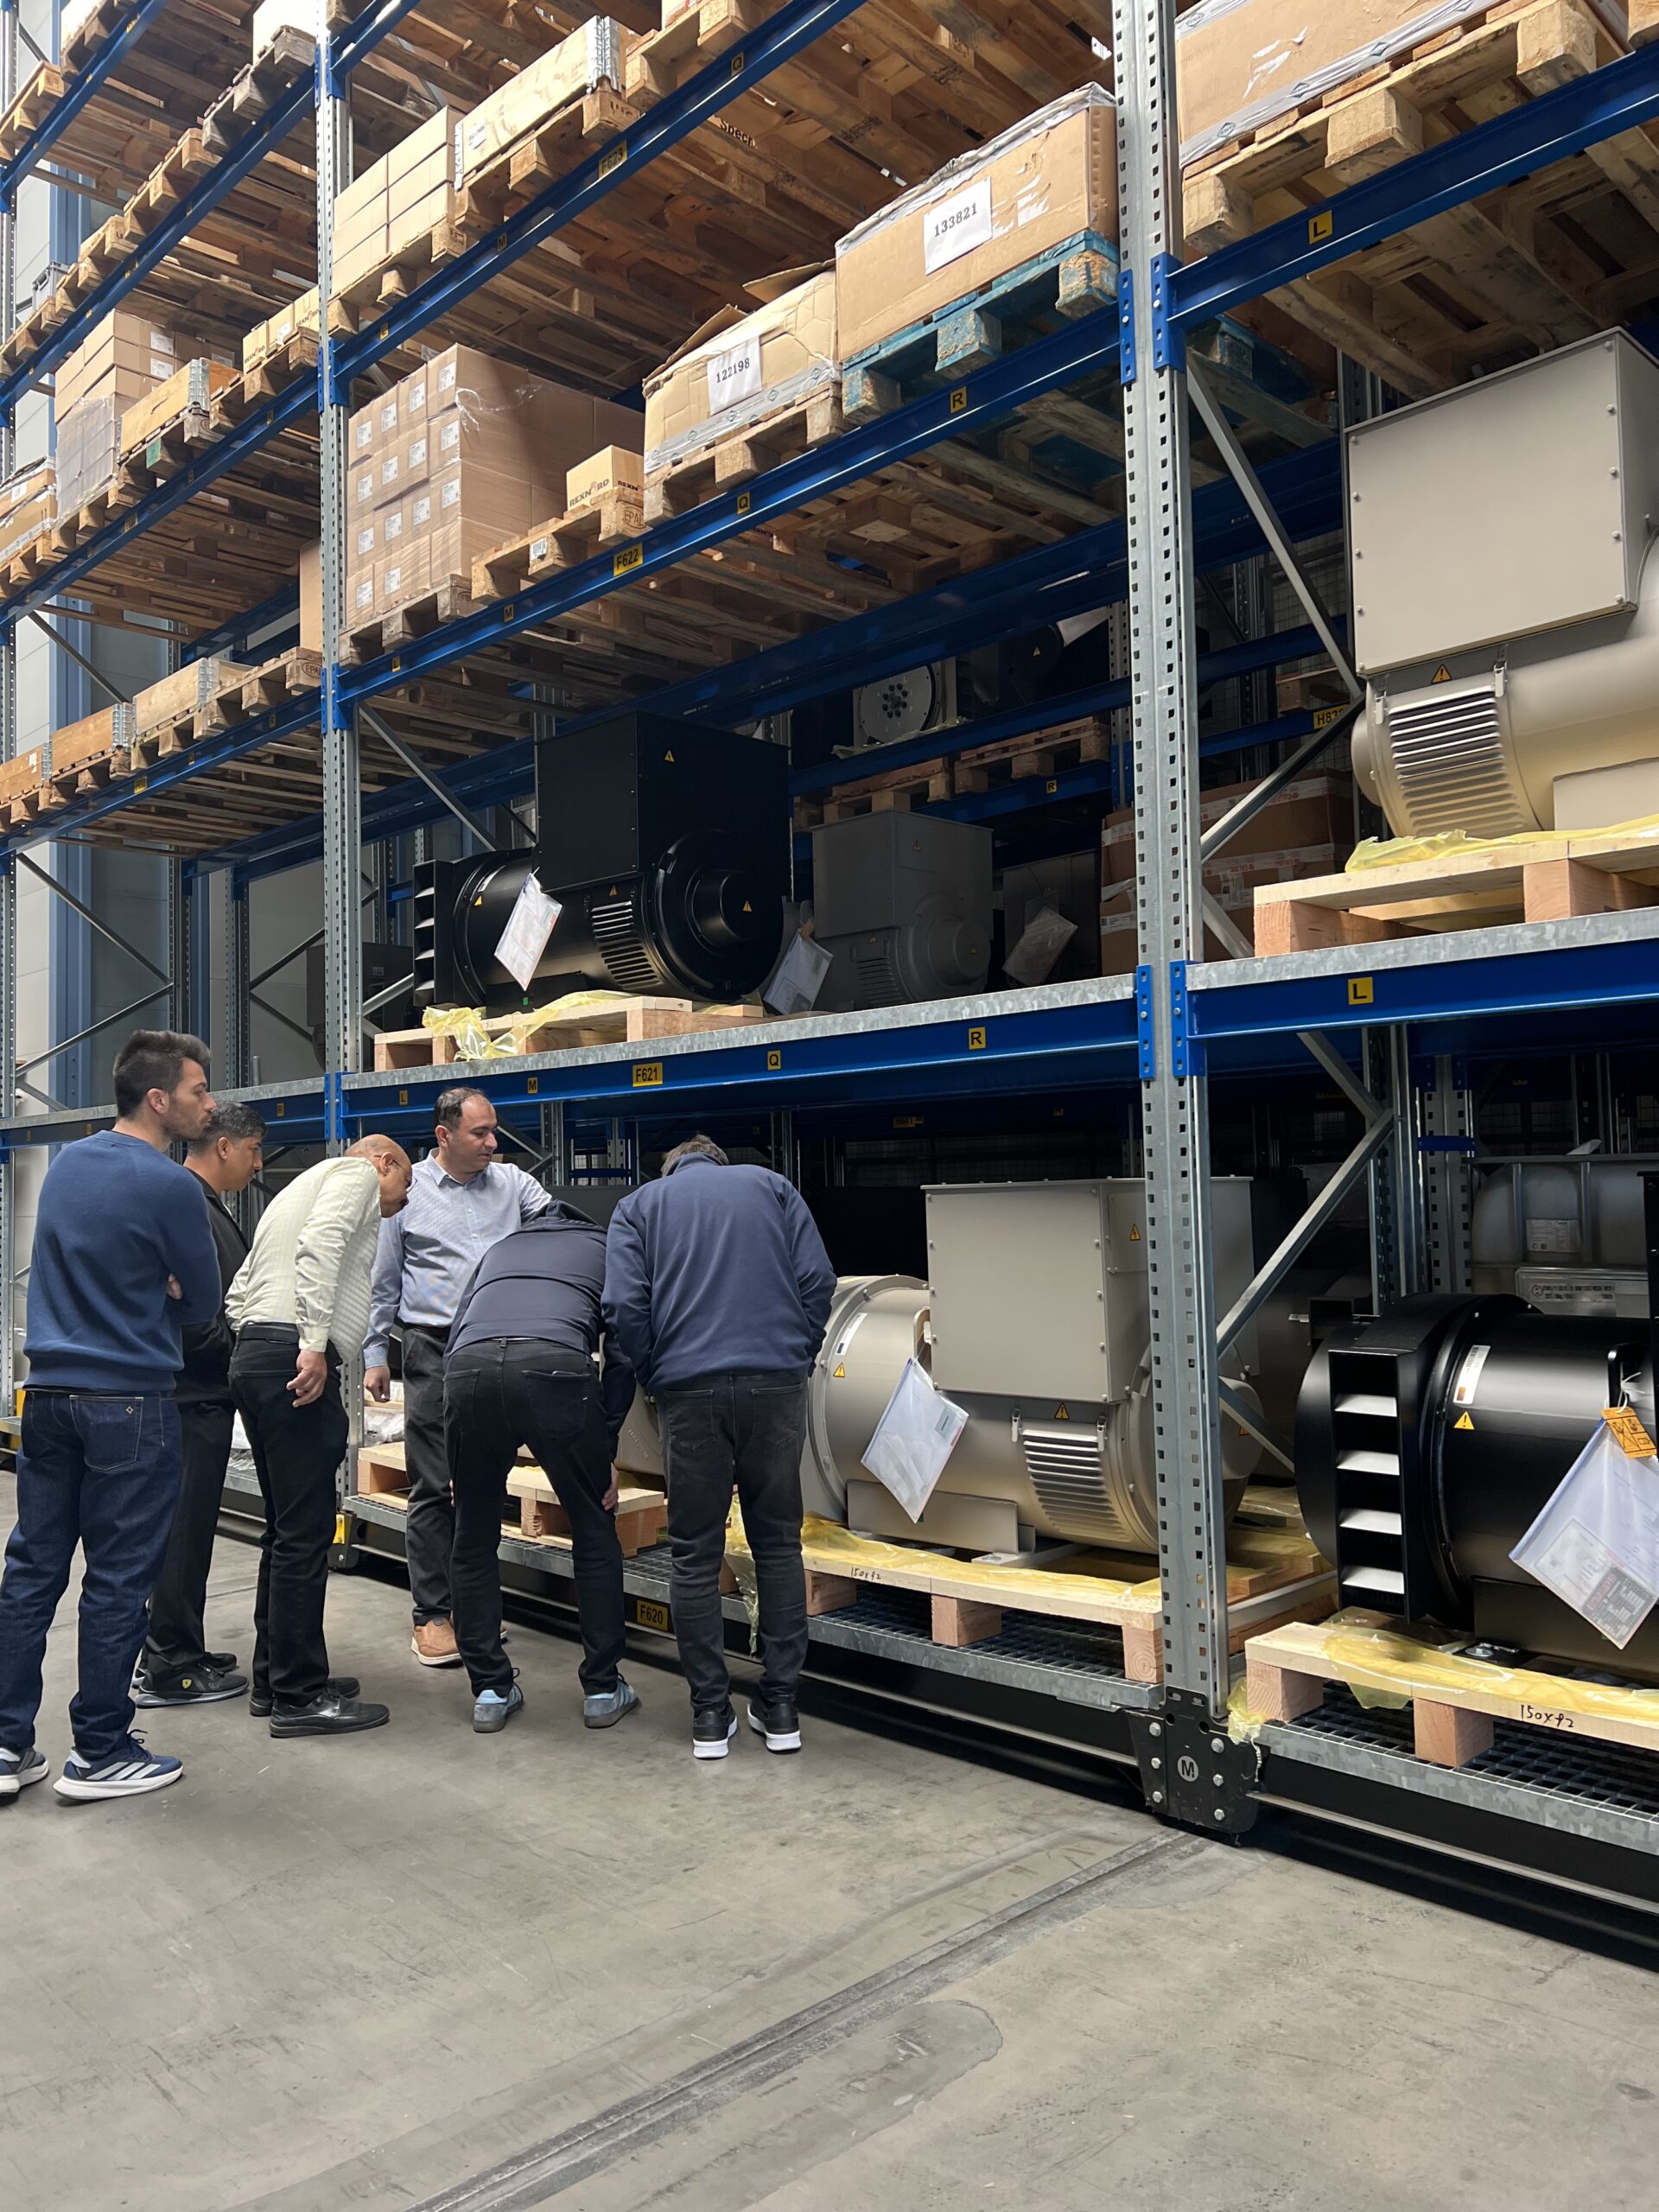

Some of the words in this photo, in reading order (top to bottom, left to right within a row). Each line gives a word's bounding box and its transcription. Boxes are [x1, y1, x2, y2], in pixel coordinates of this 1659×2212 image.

[733, 56, 742, 70] Q
[601, 147, 623, 175] F623
[934, 202, 977, 237] 133821
[1313, 221, 1326, 238] L
[499, 234, 506, 248] M
[715, 357, 750, 384] 122198
[952, 391, 963, 408] R
[569, 479, 609, 507] REXNORD
[739, 496, 748, 509] Q
[616, 548, 639, 569] F622
[505, 607, 512, 618] M
[1047, 782, 1055, 791] R
[1352, 983, 1367, 1000] L
[970, 1031, 982, 1046] R
[769, 1053, 779, 1066] Q
[636, 1066, 658, 1083] F621
[529, 1079, 537, 1090] M
[400, 1092, 406, 1103] L
[640, 1604, 664, 1625] F620
[1181, 1759, 1195, 1778] M
